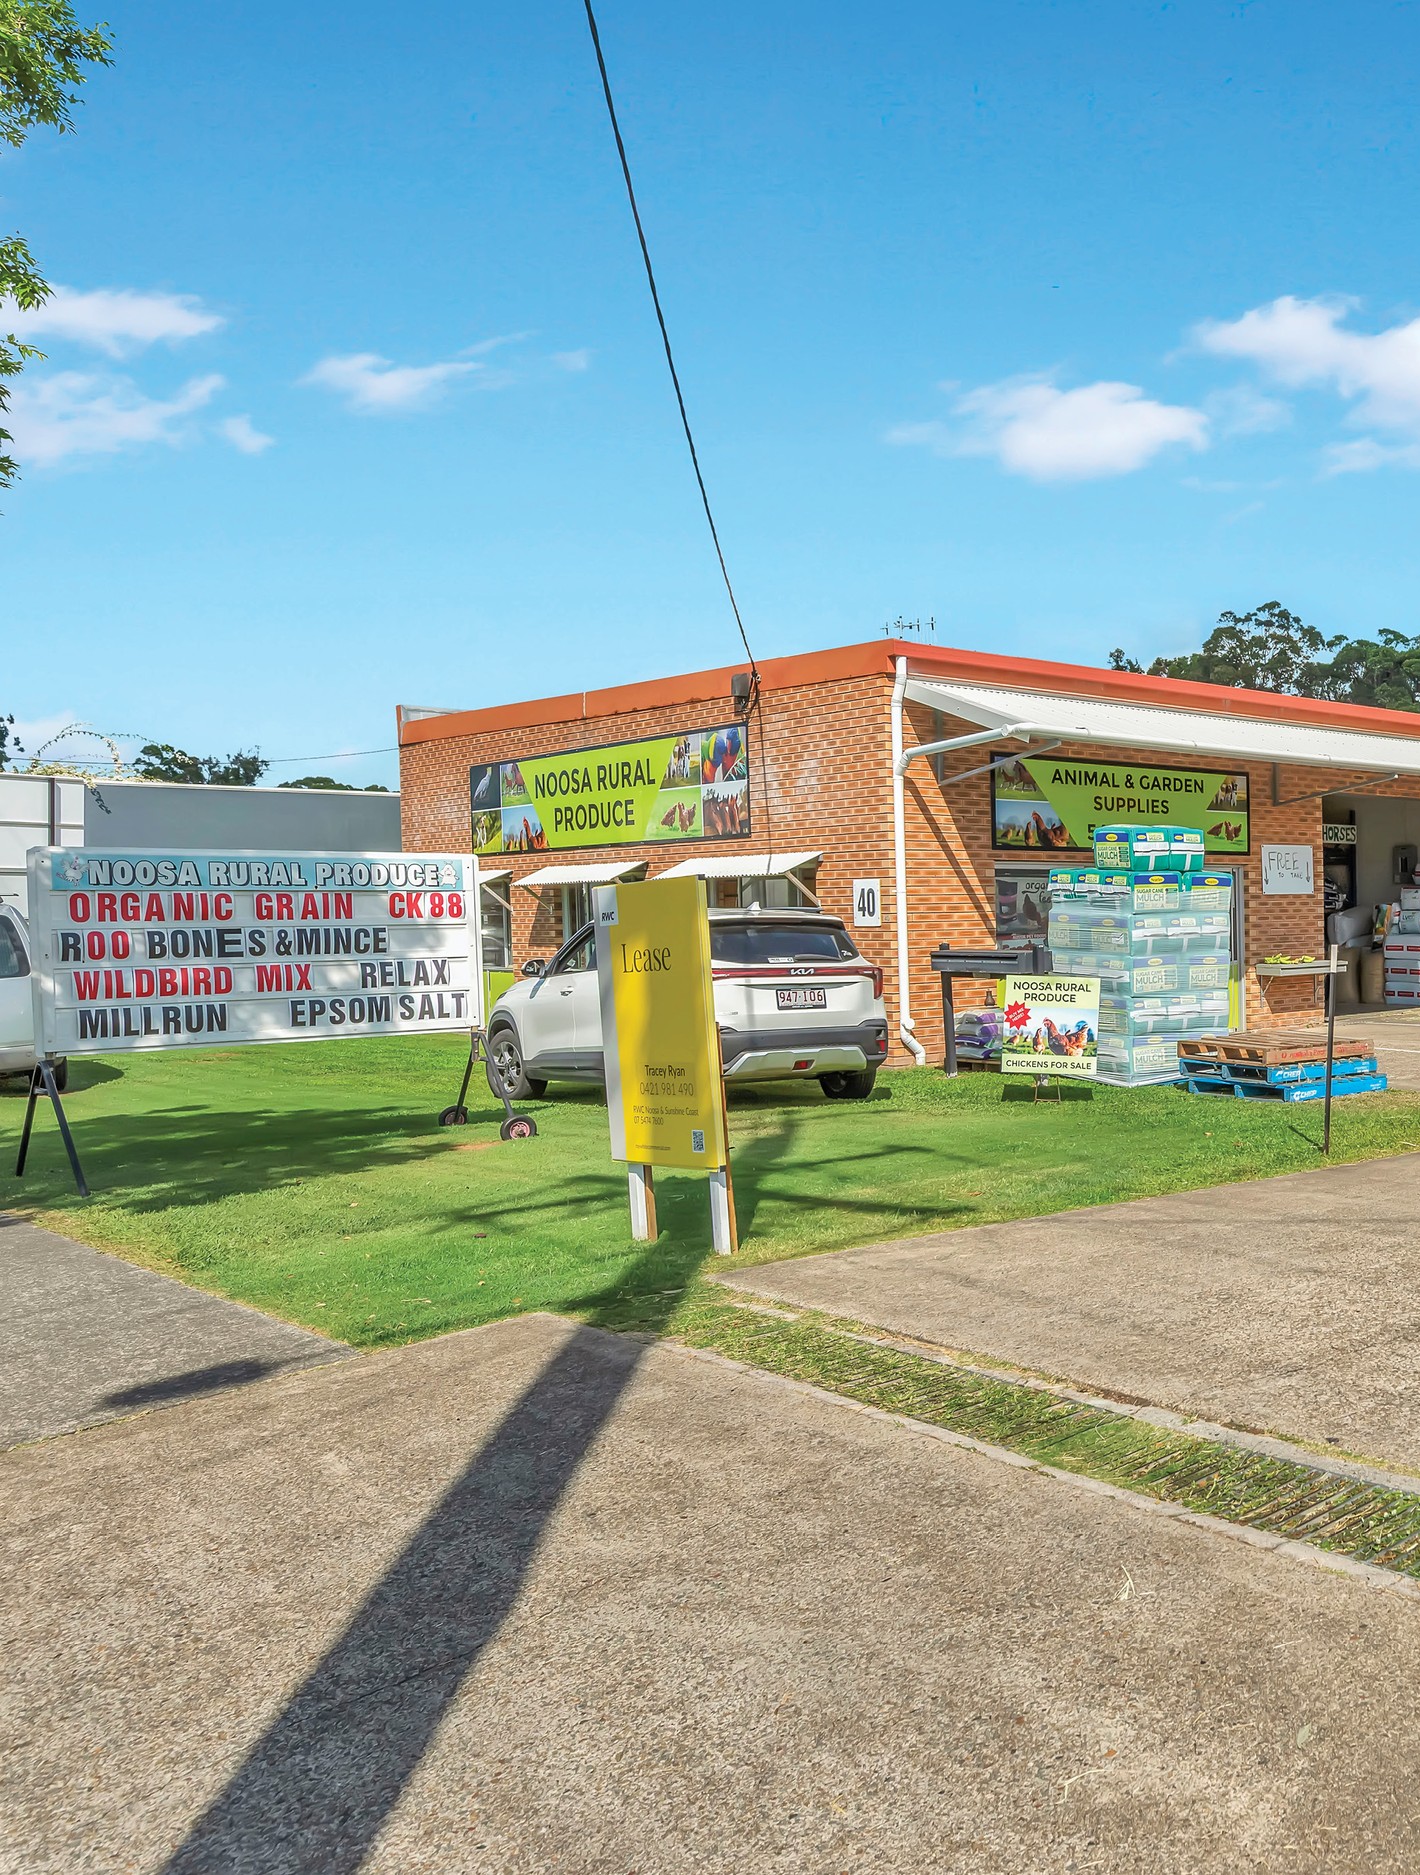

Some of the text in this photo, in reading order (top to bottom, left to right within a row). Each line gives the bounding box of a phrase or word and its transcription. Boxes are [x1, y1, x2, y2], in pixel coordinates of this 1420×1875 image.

[534, 758, 656, 800] NOOSA RURAL
[1051, 768, 1205, 793] ANIMAL & GARDEN
[1093, 796, 1170, 815] SUPPLIES
[554, 798, 635, 833] PRODUCE
[1323, 825, 1356, 842] HORSES
[1097, 851, 1118, 860] MULCH
[1268, 851, 1299, 871] FREE
[88, 859, 440, 887] NOOSA RURAL PRODUCE
[857, 887, 875, 917] 40
[1136, 894, 1164, 902] MULCH
[70, 892, 233, 923] ORGANIC
[256, 893, 353, 920] GRAIN
[601, 911, 614, 921] RWC
[61, 931, 130, 962] ROO
[148, 928, 266, 959] BONES
[621, 943, 672, 973] Lease
[73, 959, 450, 1001] WILDBIRD MIX RELAX
[1013, 982, 1091, 992] NOOSA RURAL
[1135, 976, 1164, 985] MULCH
[1191, 974, 1216, 982] MULCH
[1024, 993, 1076, 1003] PRODUCE
[79, 992, 465, 1040] MILLRUN EPSOM SALT
[1006, 1060, 1091, 1070] CHICKENS FOR SALE
[1135, 1054, 1164, 1063] MULCH
[644, 1065, 685, 1079] Tracey Ryan
[640, 1082, 694, 1096] 0421 981 490
